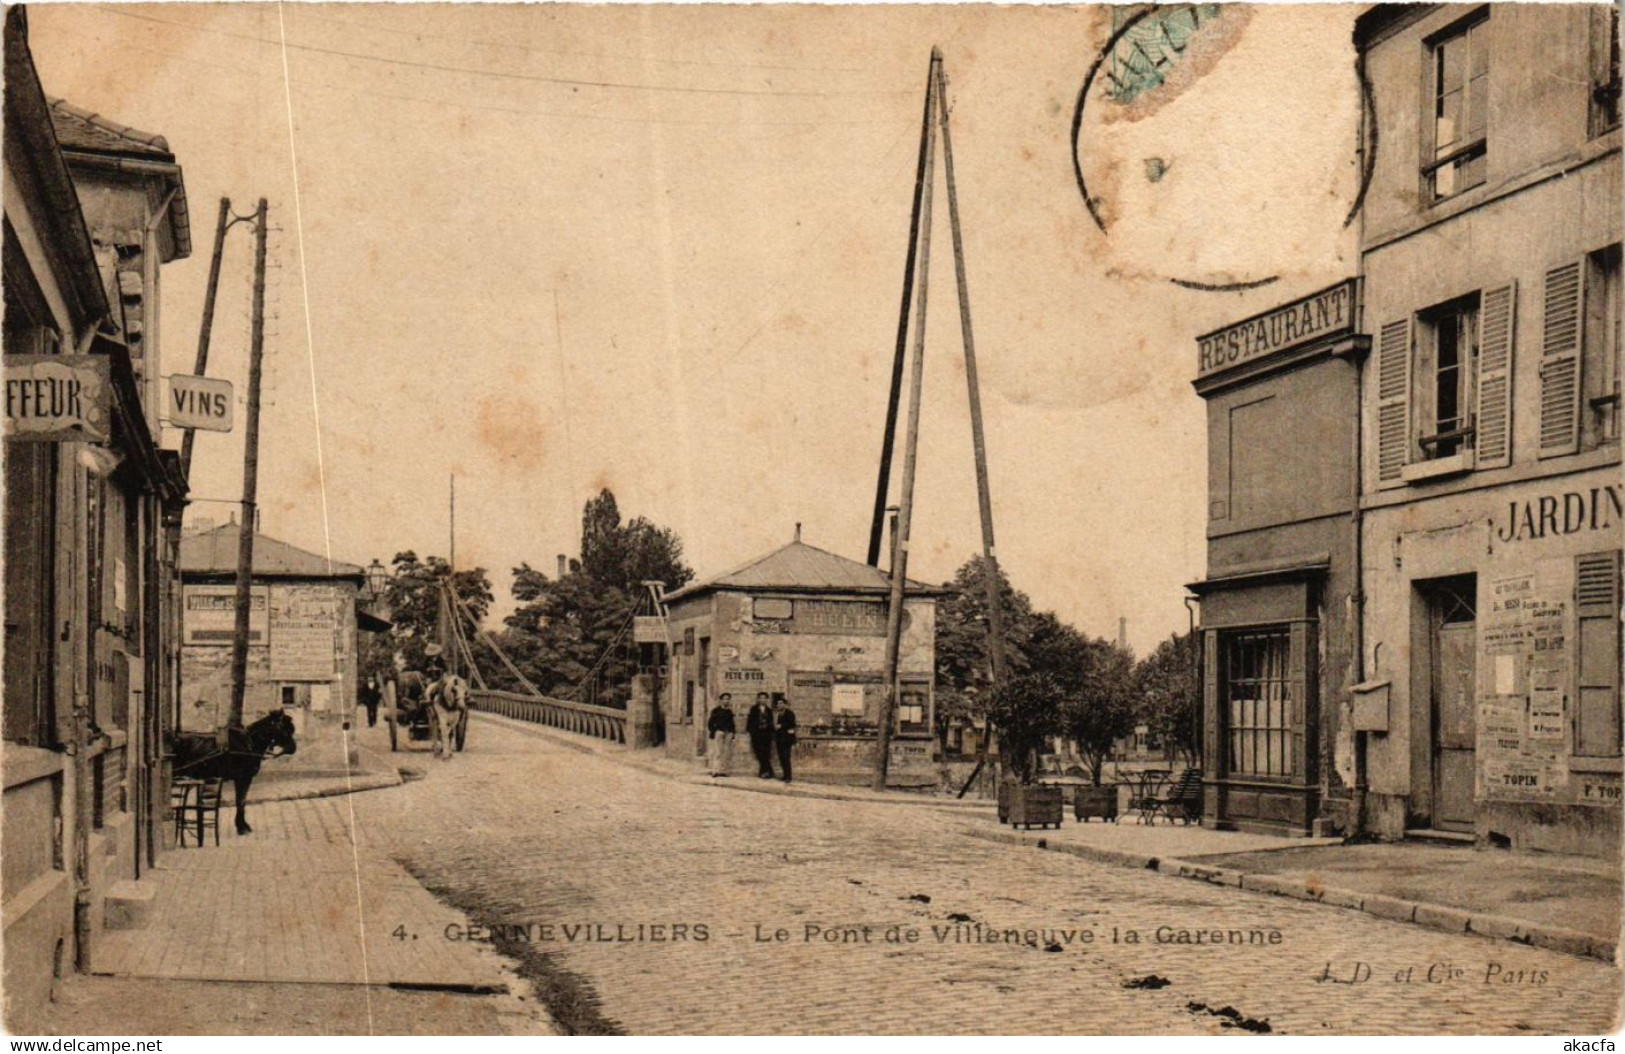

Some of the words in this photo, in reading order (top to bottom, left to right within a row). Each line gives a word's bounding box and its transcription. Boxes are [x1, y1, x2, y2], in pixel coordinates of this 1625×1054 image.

[1200, 288, 1347, 371] RESTAURANT
[173, 387, 226, 418] VINS
[1503, 774, 1538, 786] TOPIN
